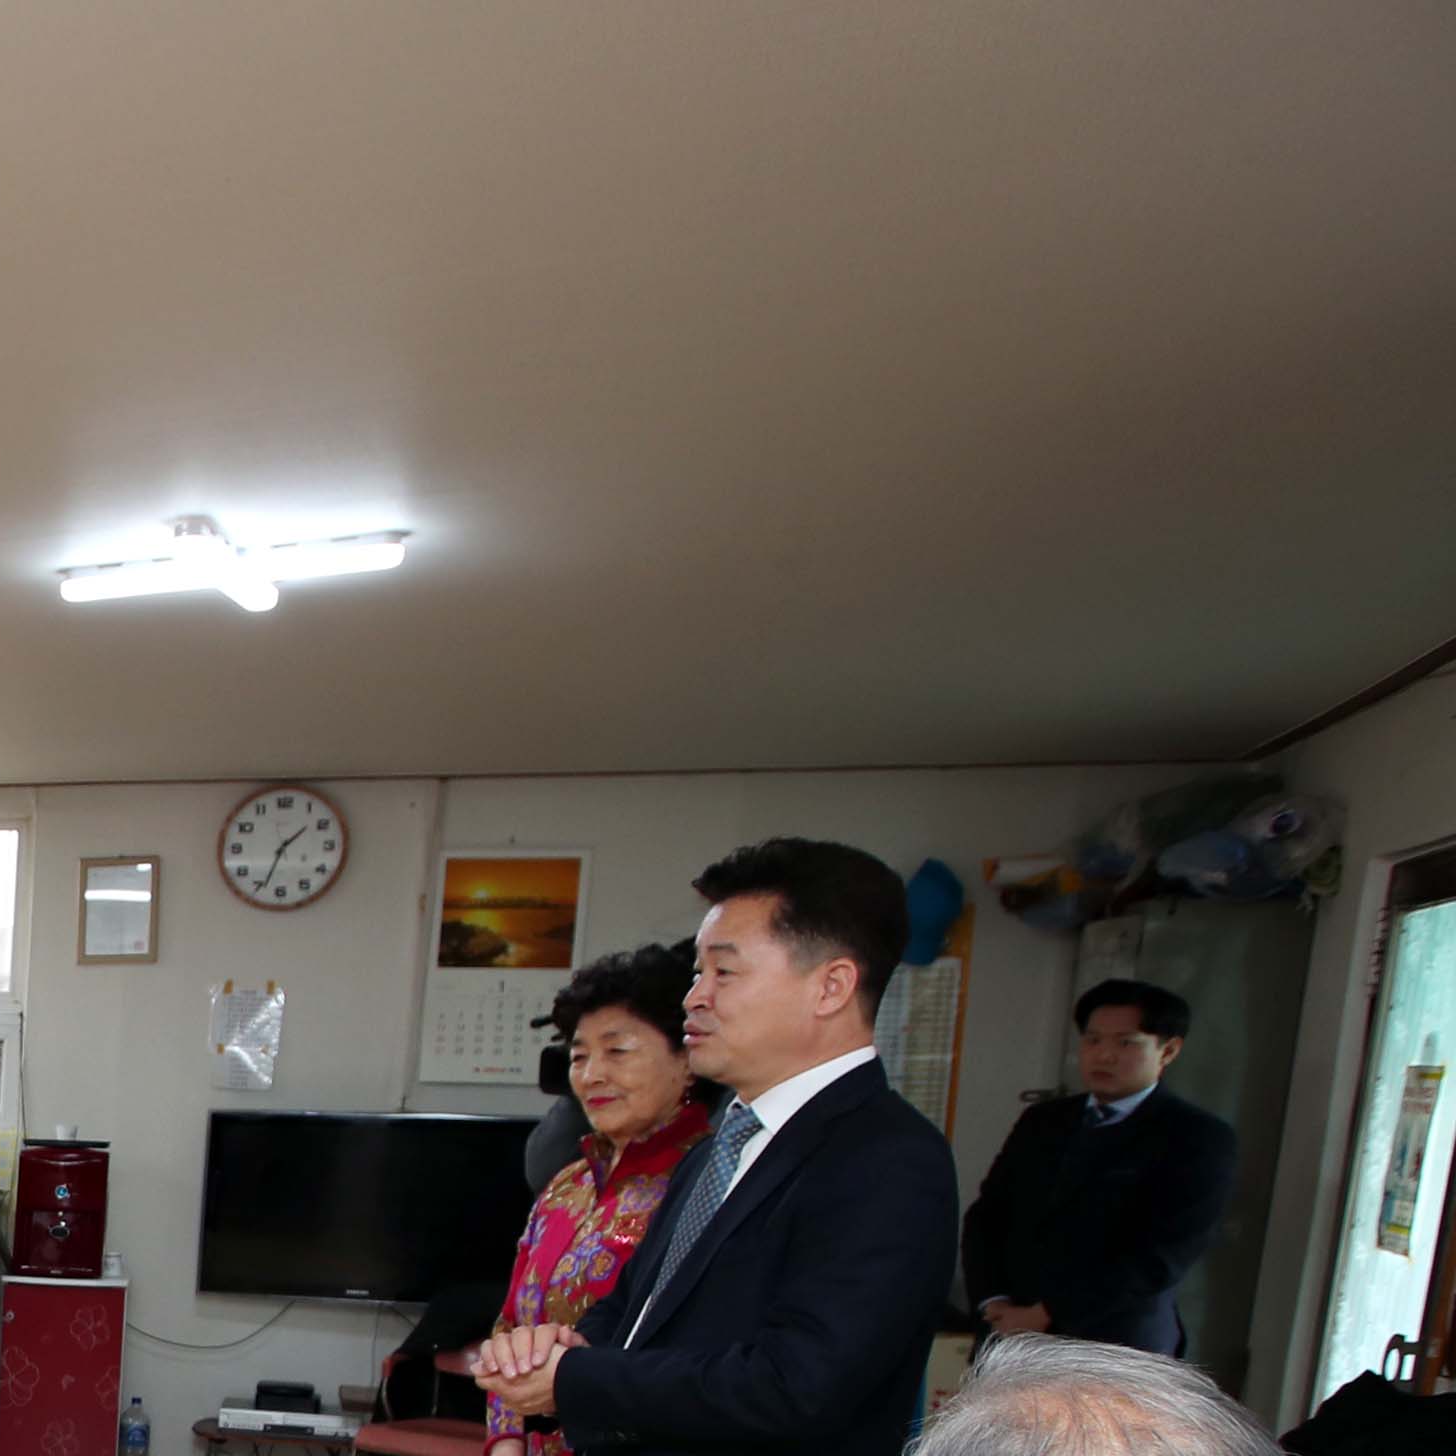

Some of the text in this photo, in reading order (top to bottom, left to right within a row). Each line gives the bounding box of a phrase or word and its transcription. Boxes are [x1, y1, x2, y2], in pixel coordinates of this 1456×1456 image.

[277, 797, 293, 808] 12
[256, 803, 266, 815] 11
[238, 821, 254, 834] 10
[316, 818, 329, 830] 2
[231, 842, 243, 854] 9
[323, 840, 335, 851] 3
[237, 865, 248, 877] 8
[315, 863, 327, 874] 4
[253, 881, 264, 892] 7
[299, 879, 310, 890] 5
[275, 886, 286, 898] 6
